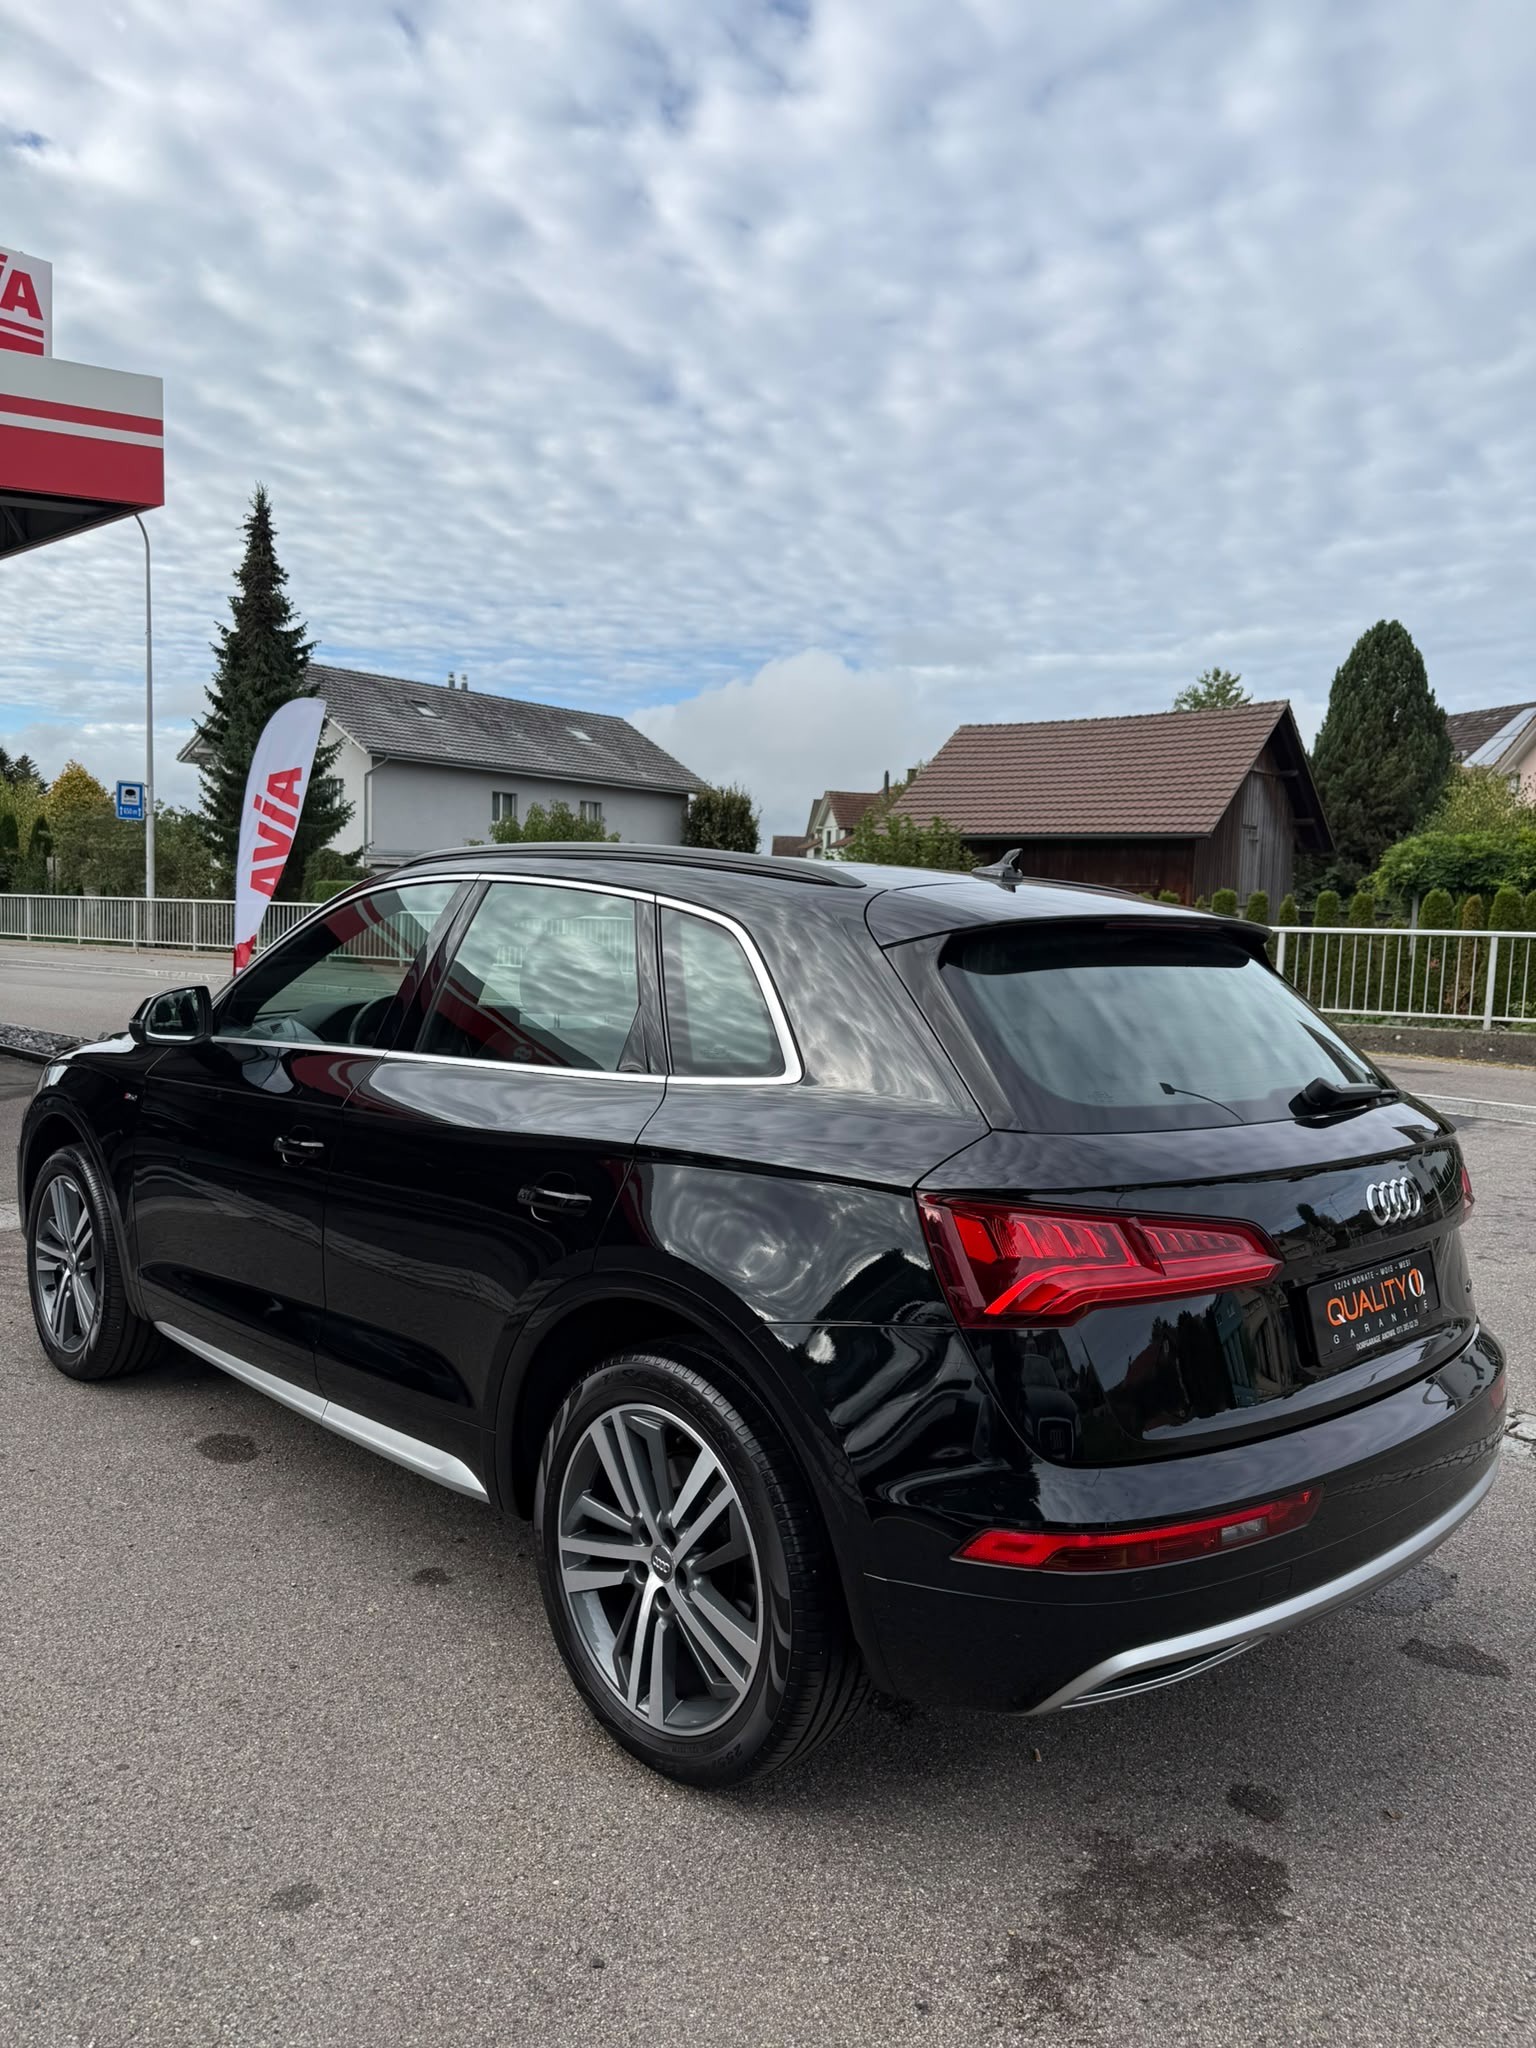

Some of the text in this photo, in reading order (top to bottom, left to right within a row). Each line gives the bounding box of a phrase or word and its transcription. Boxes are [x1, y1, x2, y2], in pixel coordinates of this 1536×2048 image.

[1327, 1273, 1407, 1327] QUALITY
[1333, 1279, 1351, 1290] 12/24
[1351, 1270, 1374, 1285] MONATE
[1333, 1298, 1429, 1345] GARANTIE
